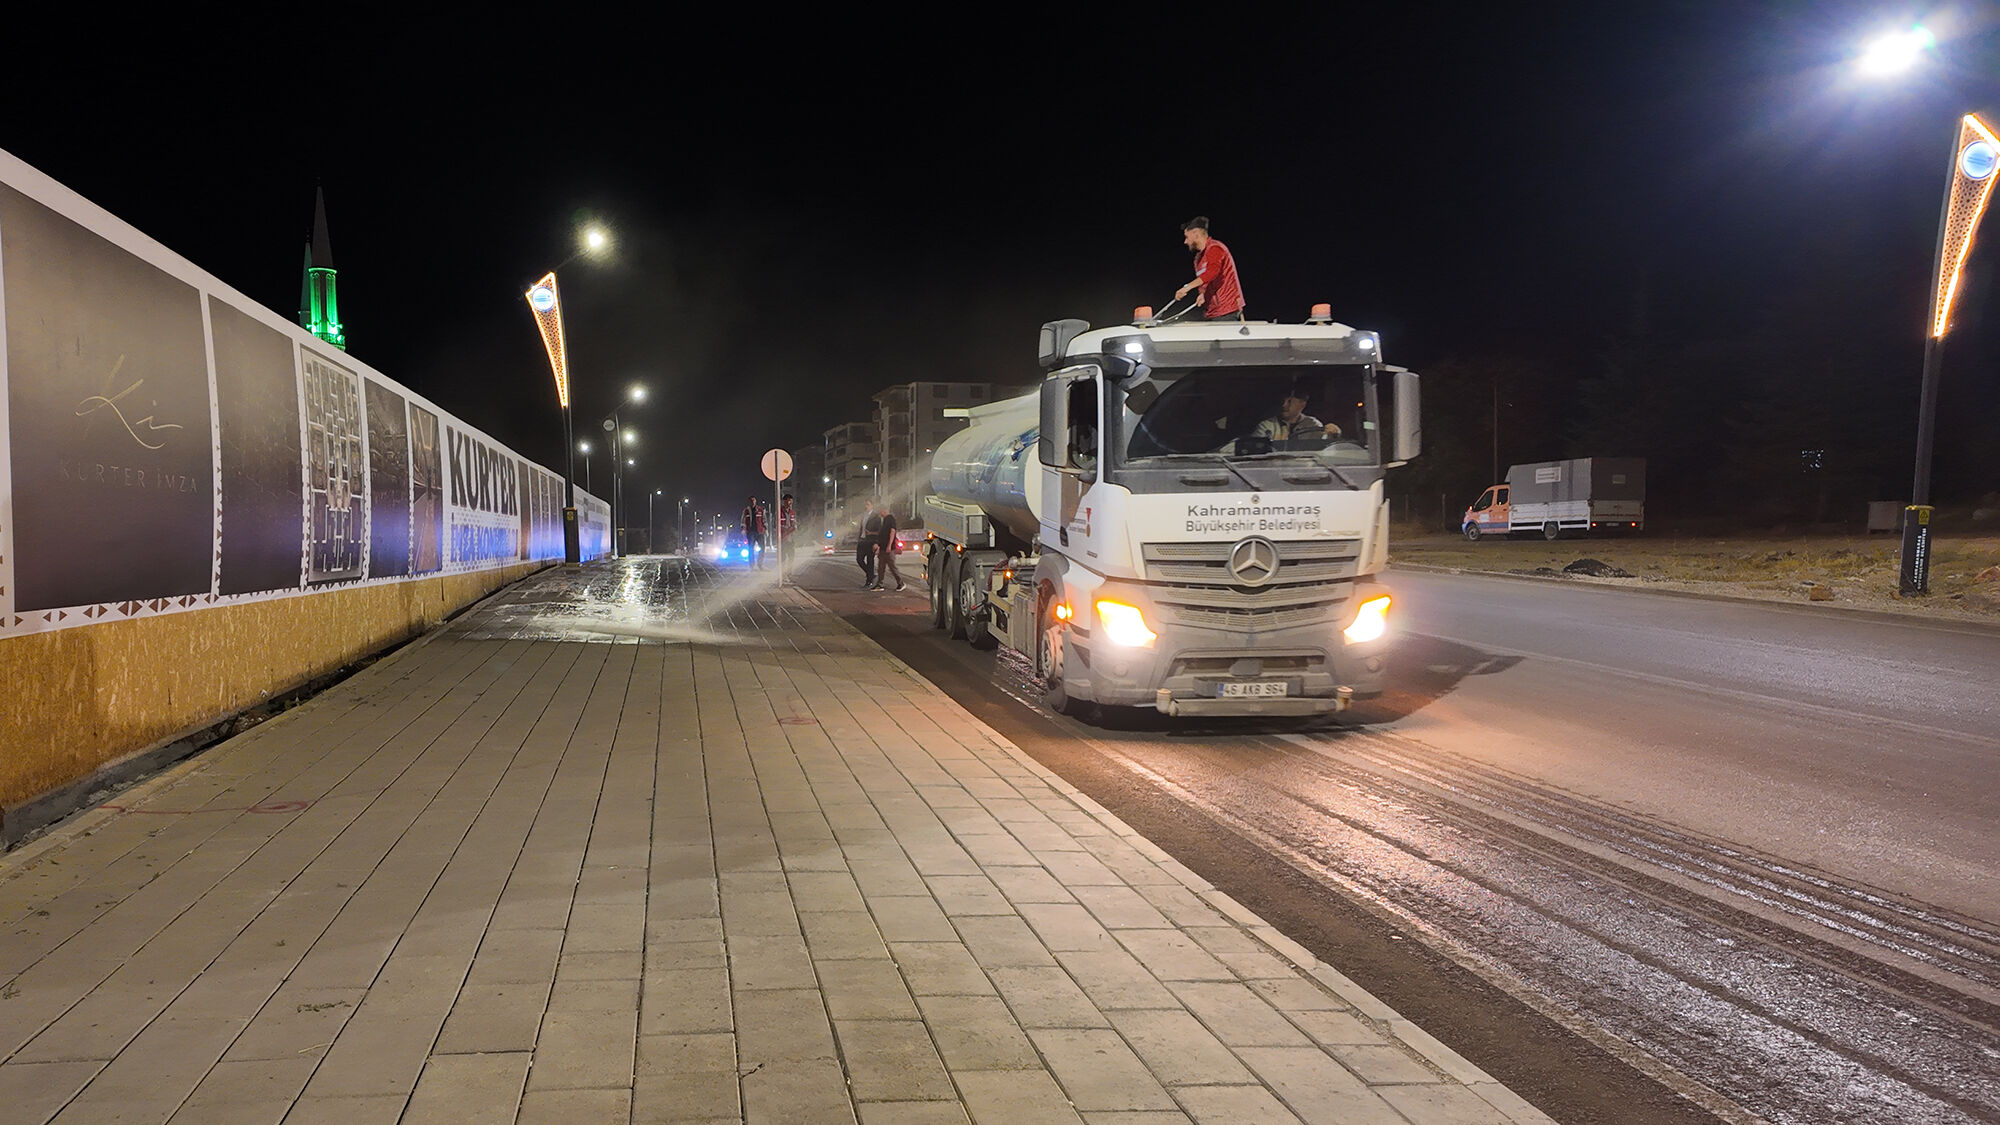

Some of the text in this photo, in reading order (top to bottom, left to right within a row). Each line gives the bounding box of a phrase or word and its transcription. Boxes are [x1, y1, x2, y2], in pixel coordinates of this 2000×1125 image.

[446, 424, 518, 517] KURTER
[1187, 504, 1321, 517] Kahramanmaraş
[1186, 518, 1321, 534] Büyükşehir Belediyesi
